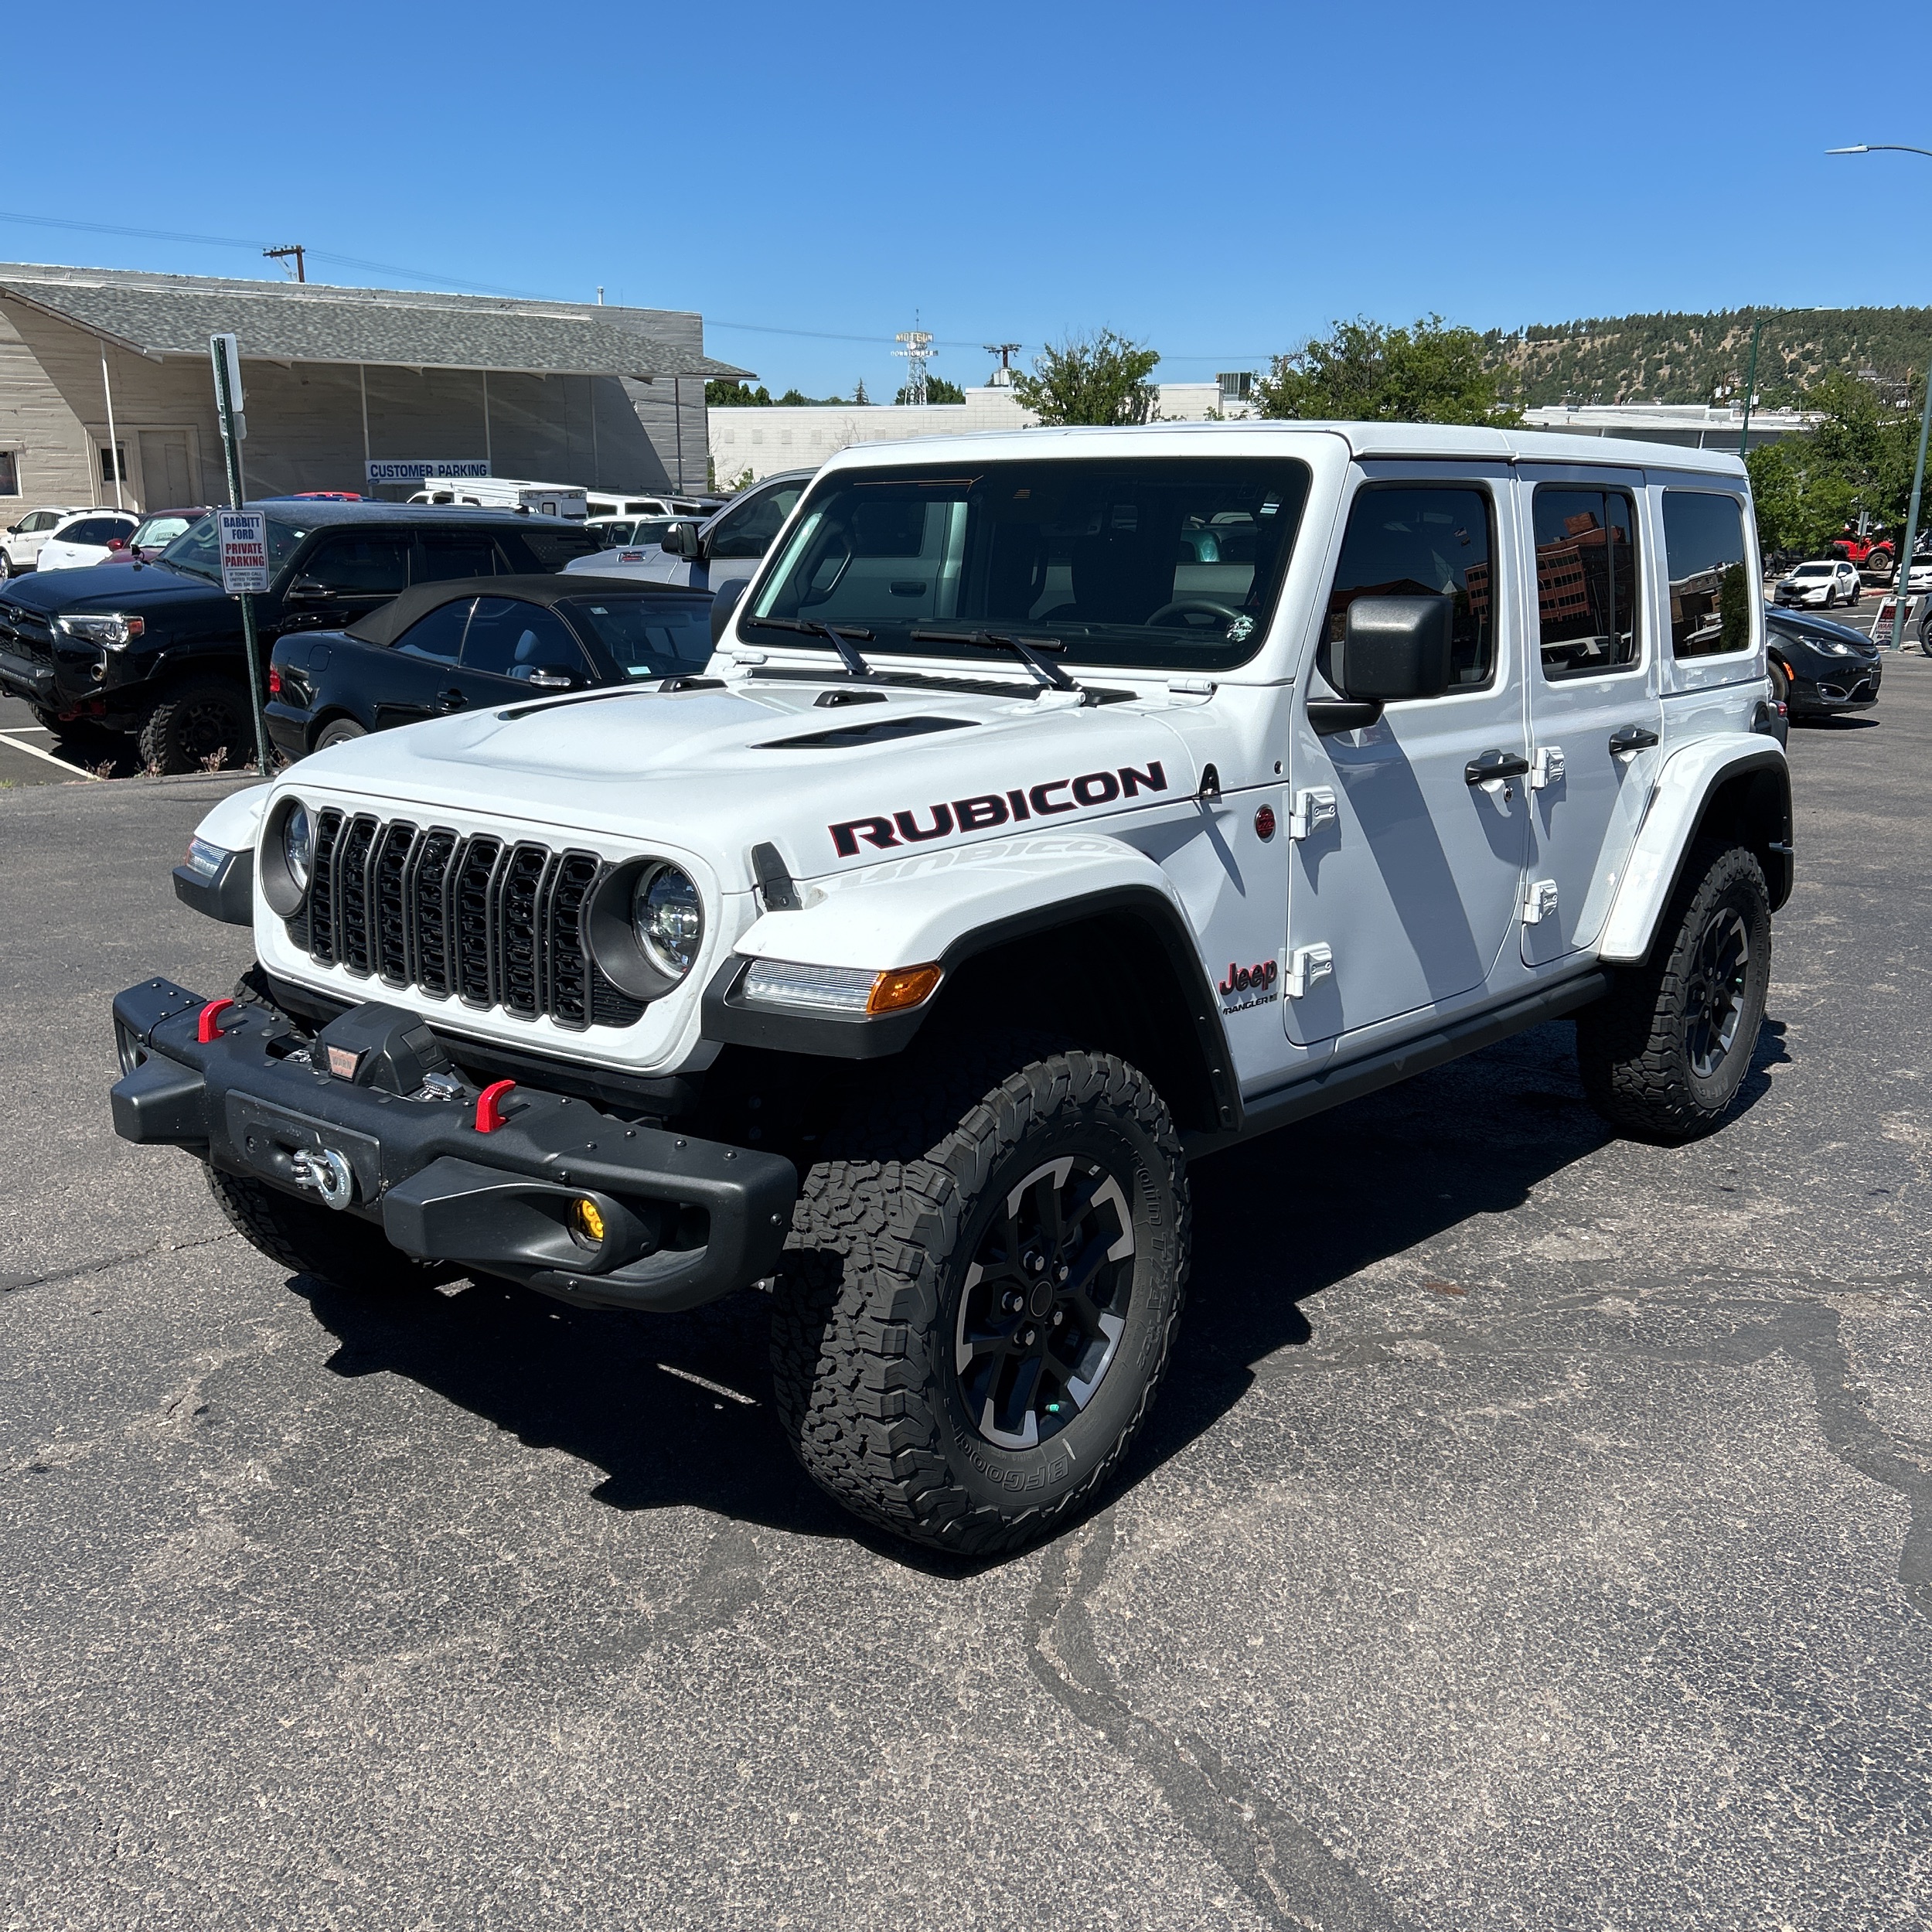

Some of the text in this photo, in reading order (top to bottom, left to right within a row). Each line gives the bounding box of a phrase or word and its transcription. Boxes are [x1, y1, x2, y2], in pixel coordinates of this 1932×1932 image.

[370, 464, 487, 477] CUSTOMER PARKING
[223, 516, 261, 528] BABBITT
[232, 529, 254, 540] FORD
[226, 543, 263, 554] PRIVATE
[225, 555, 264, 567] PARKING
[827, 761, 1168, 858] RUBICON
[1219, 960, 1278, 996] Jeep
[332, 1056, 353, 1070] WARN
